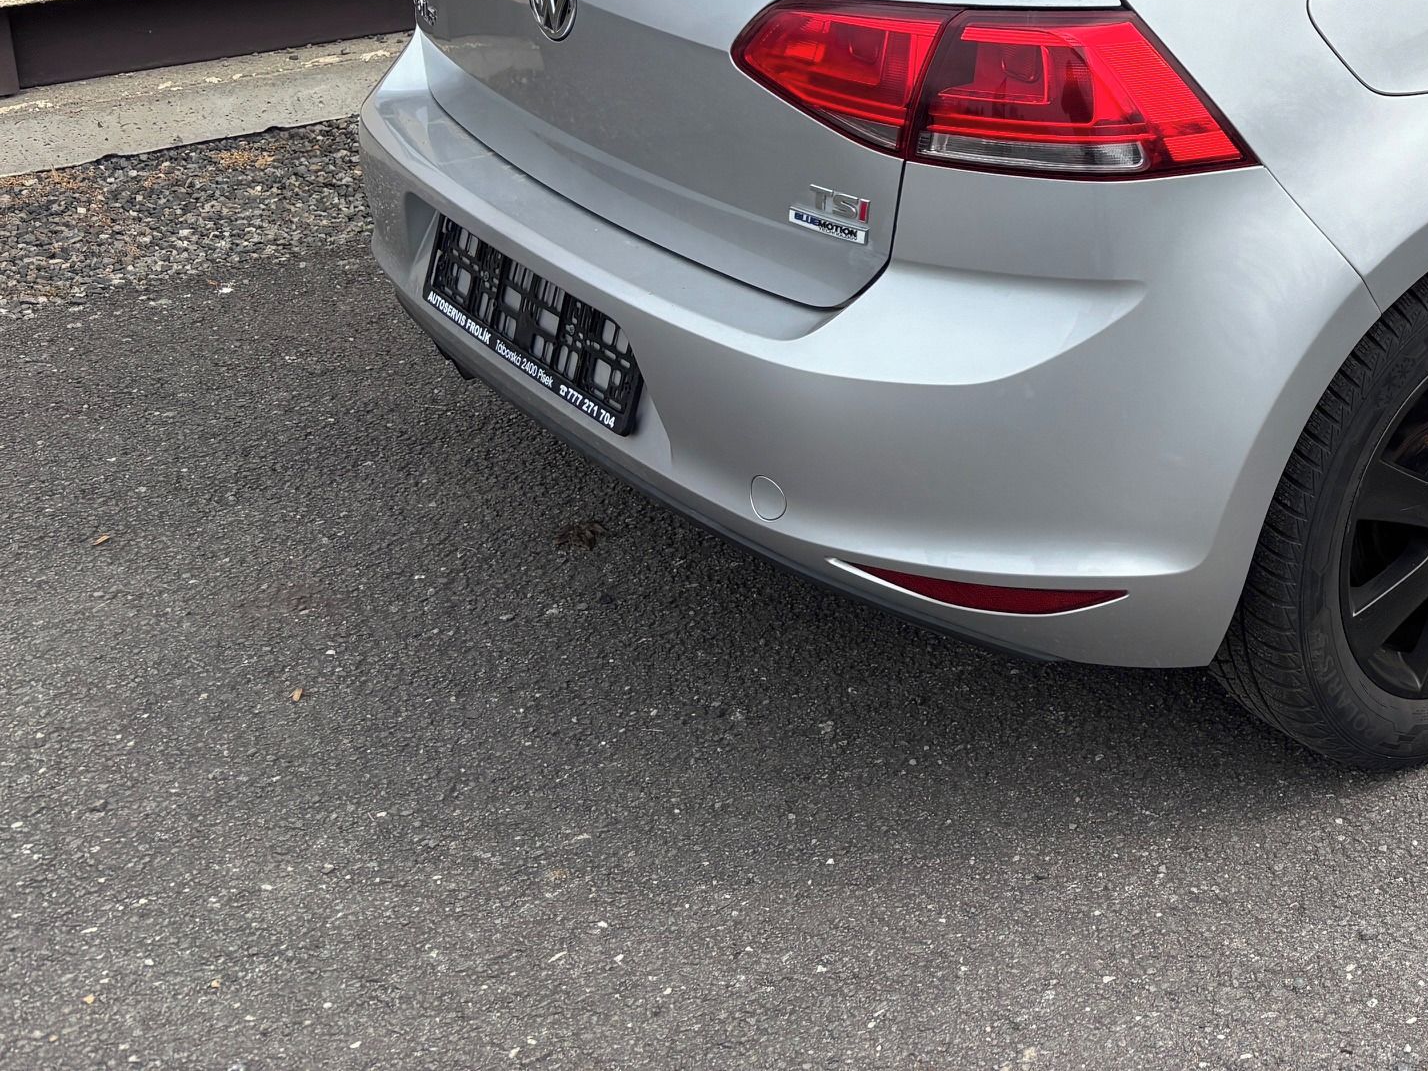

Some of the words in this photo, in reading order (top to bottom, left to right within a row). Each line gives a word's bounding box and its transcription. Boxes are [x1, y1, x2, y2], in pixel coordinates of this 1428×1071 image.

[809, 184, 870, 223] TSI
[428, 291, 467, 326] AUTOSERVIS
[465, 318, 492, 345] FROLÍK
[521, 358, 538, 376] 2400
[567, 388, 583, 406] 777
[582, 399, 598, 417] 271
[600, 409, 615, 428] 704
